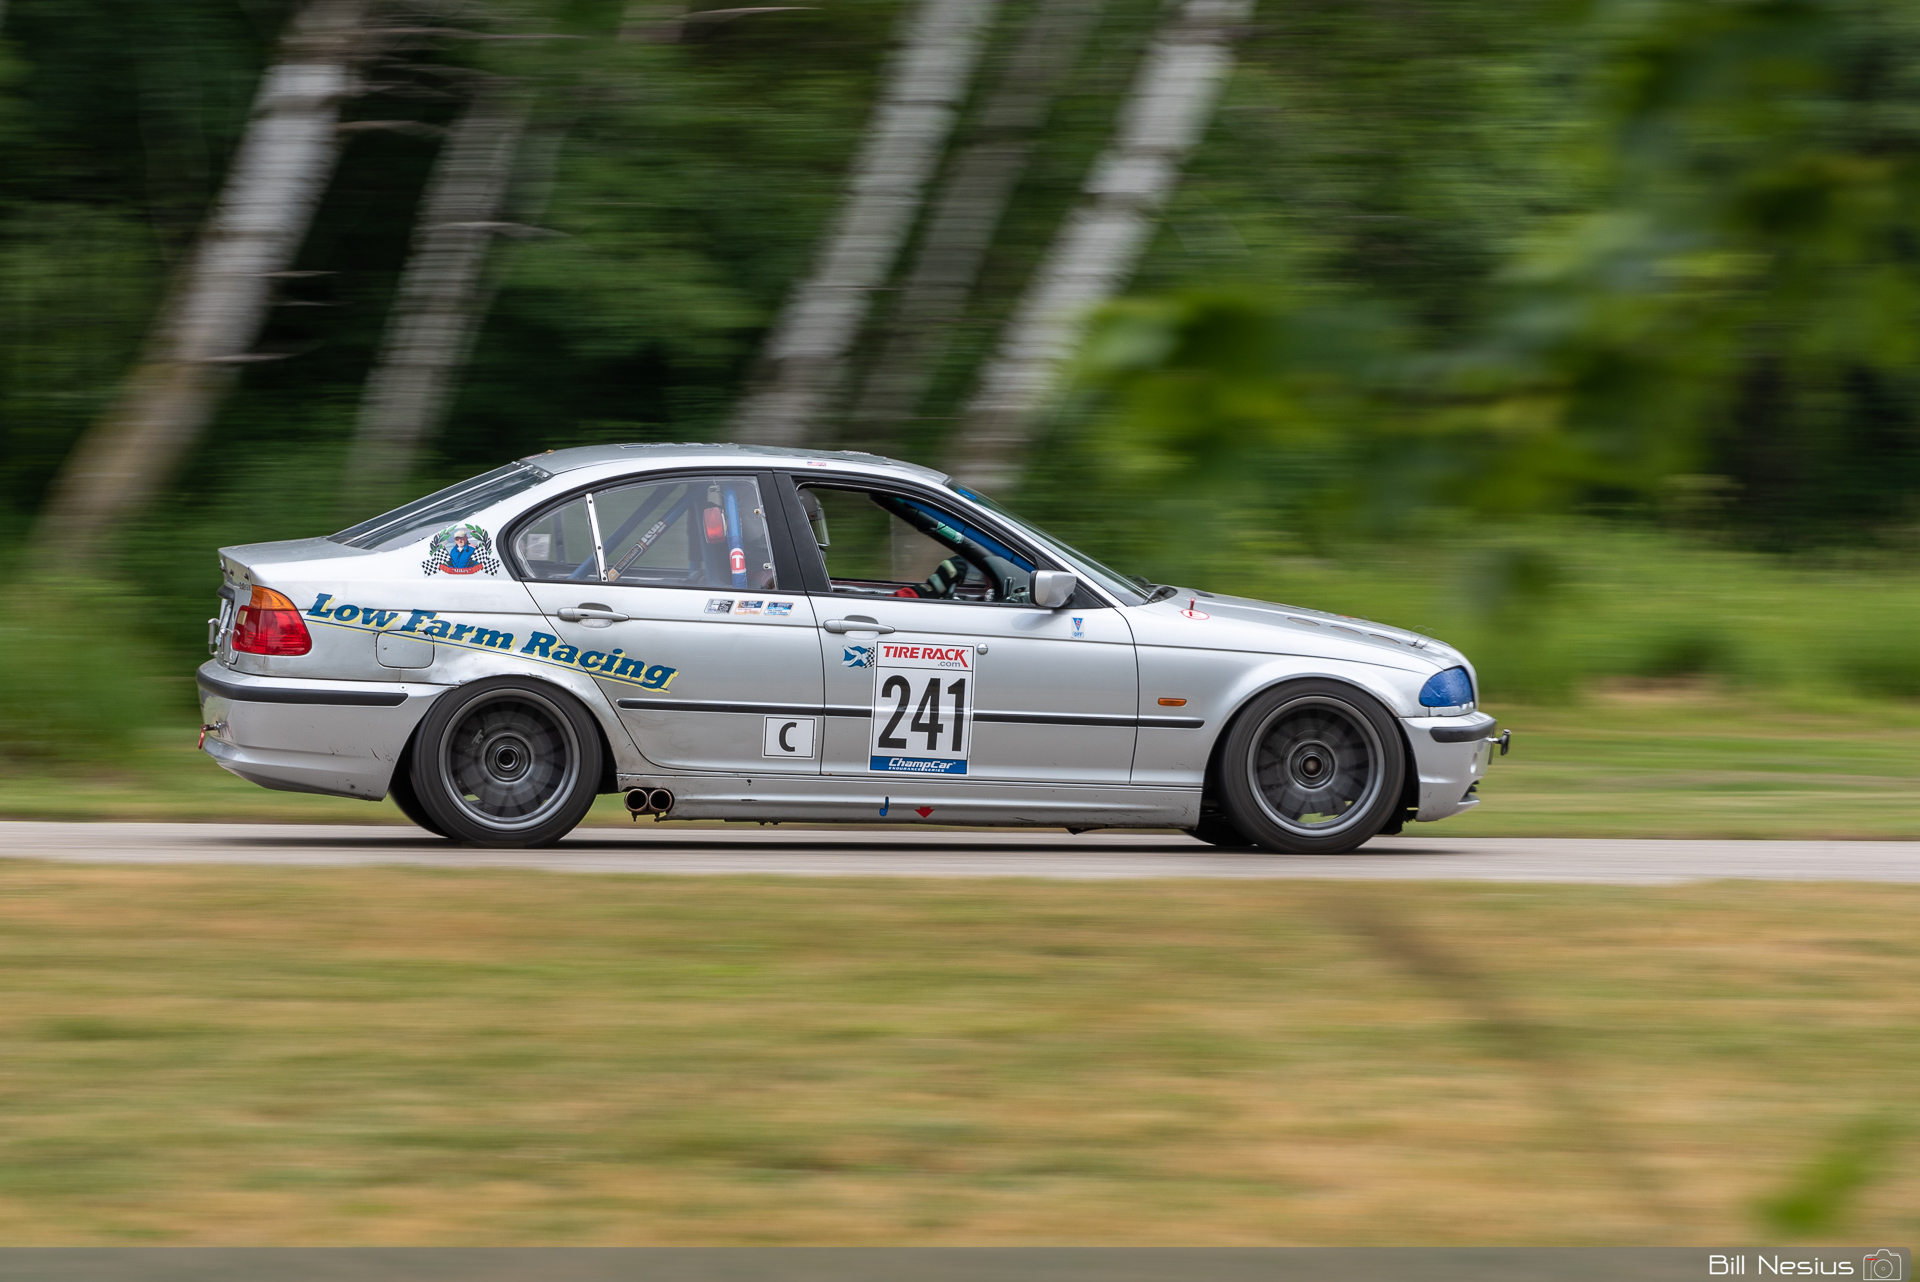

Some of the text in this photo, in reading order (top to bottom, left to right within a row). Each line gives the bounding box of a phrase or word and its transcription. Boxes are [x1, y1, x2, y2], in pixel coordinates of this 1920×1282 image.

[732, 555, 744, 568] T
[306, 593, 679, 693] Low Farm Racing
[883, 646, 969, 668] TIRE RACK
[878, 675, 966, 752] 241
[778, 722, 797, 752] C
[889, 758, 954, 771] ChampCar
